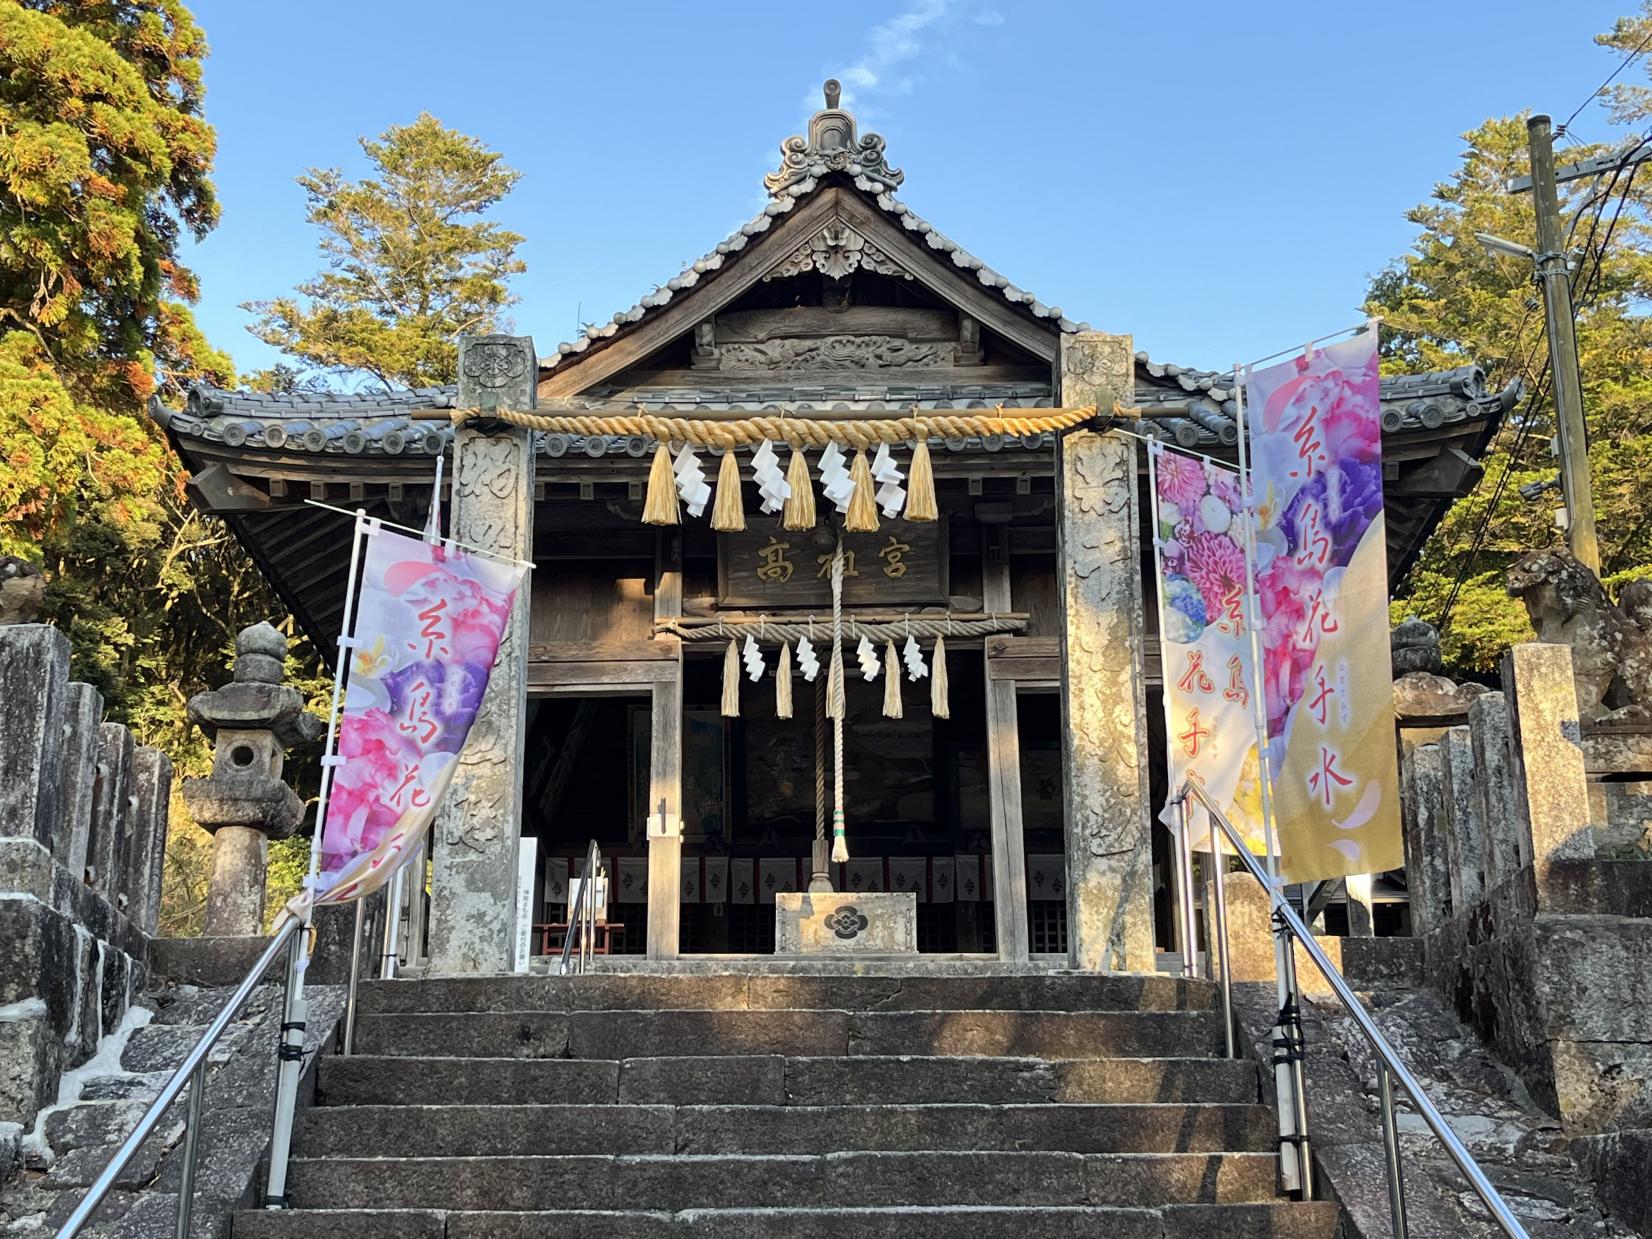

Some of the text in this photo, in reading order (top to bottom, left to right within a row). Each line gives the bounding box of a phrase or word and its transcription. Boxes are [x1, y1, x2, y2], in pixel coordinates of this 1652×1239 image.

[1217, 583, 1249, 710] 糸島
[1289, 406, 1355, 807] 糸島花手水
